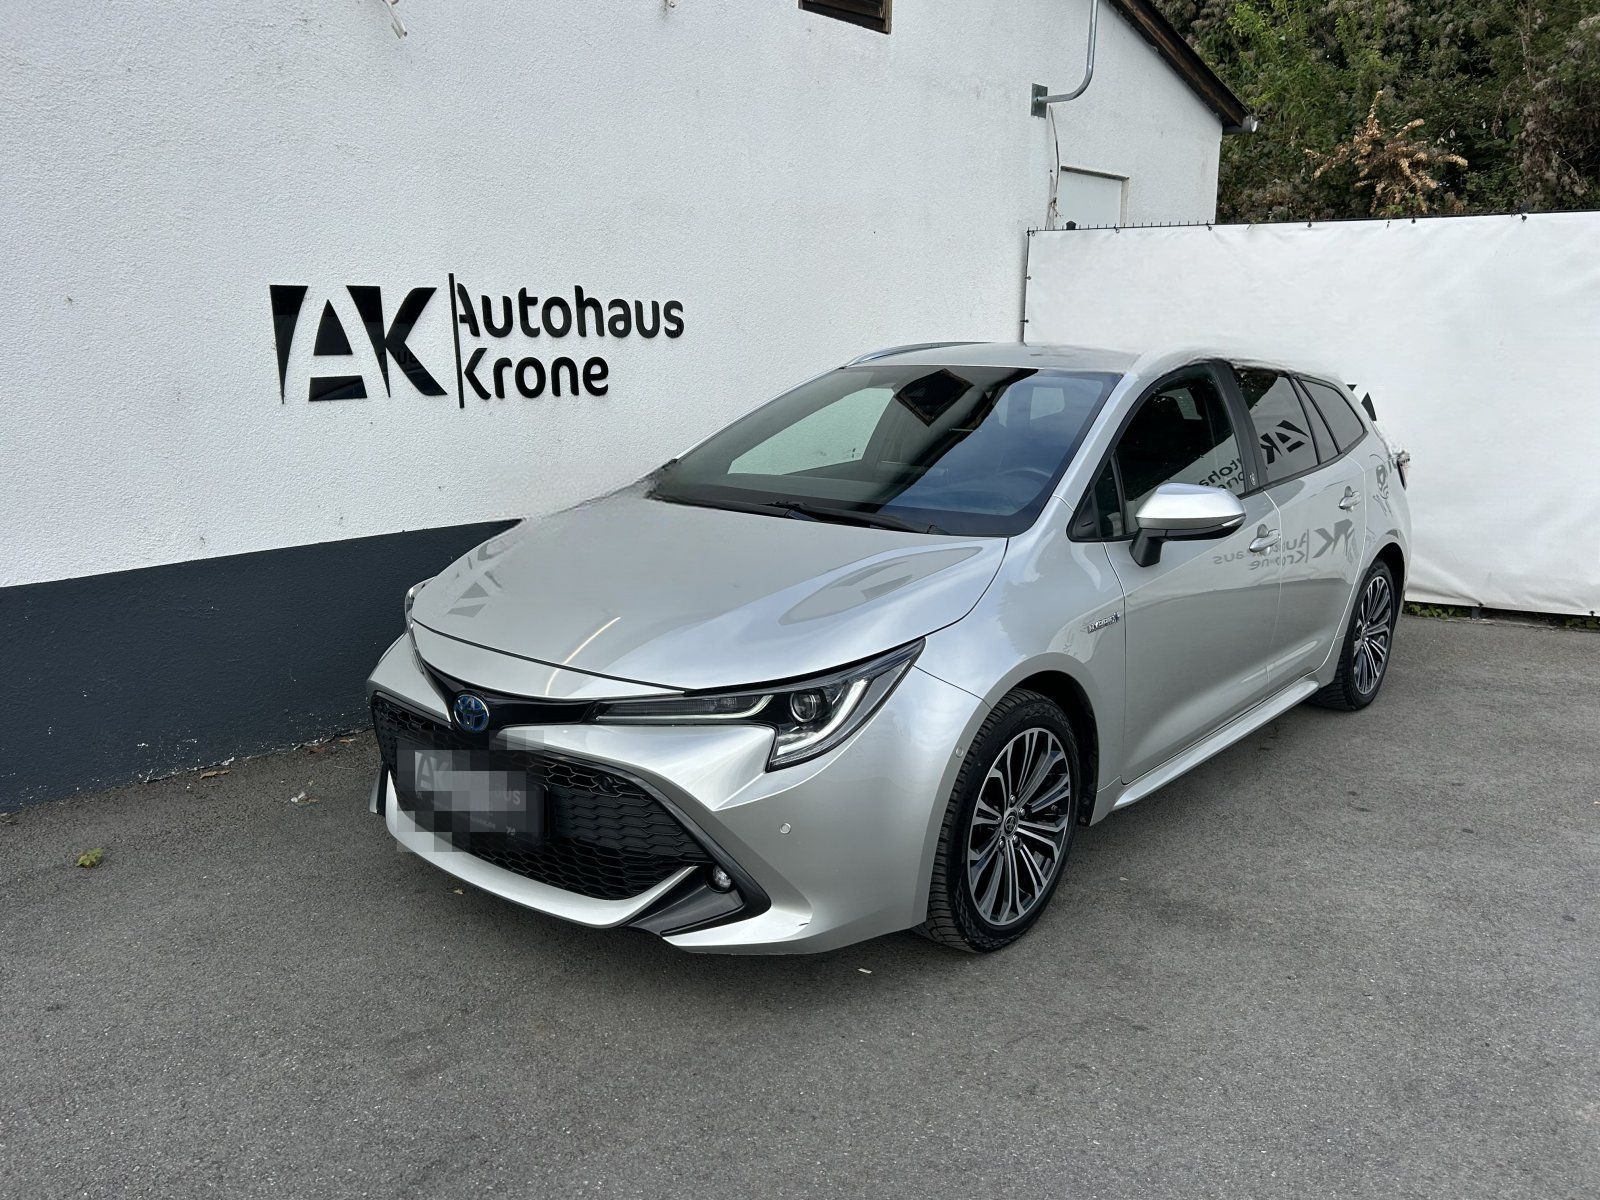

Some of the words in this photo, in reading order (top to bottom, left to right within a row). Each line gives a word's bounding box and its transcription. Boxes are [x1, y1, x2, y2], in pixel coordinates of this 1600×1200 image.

[457, 283, 685, 339] Autohaus
[269, 285, 447, 404] AK
[463, 347, 609, 401] Krone
